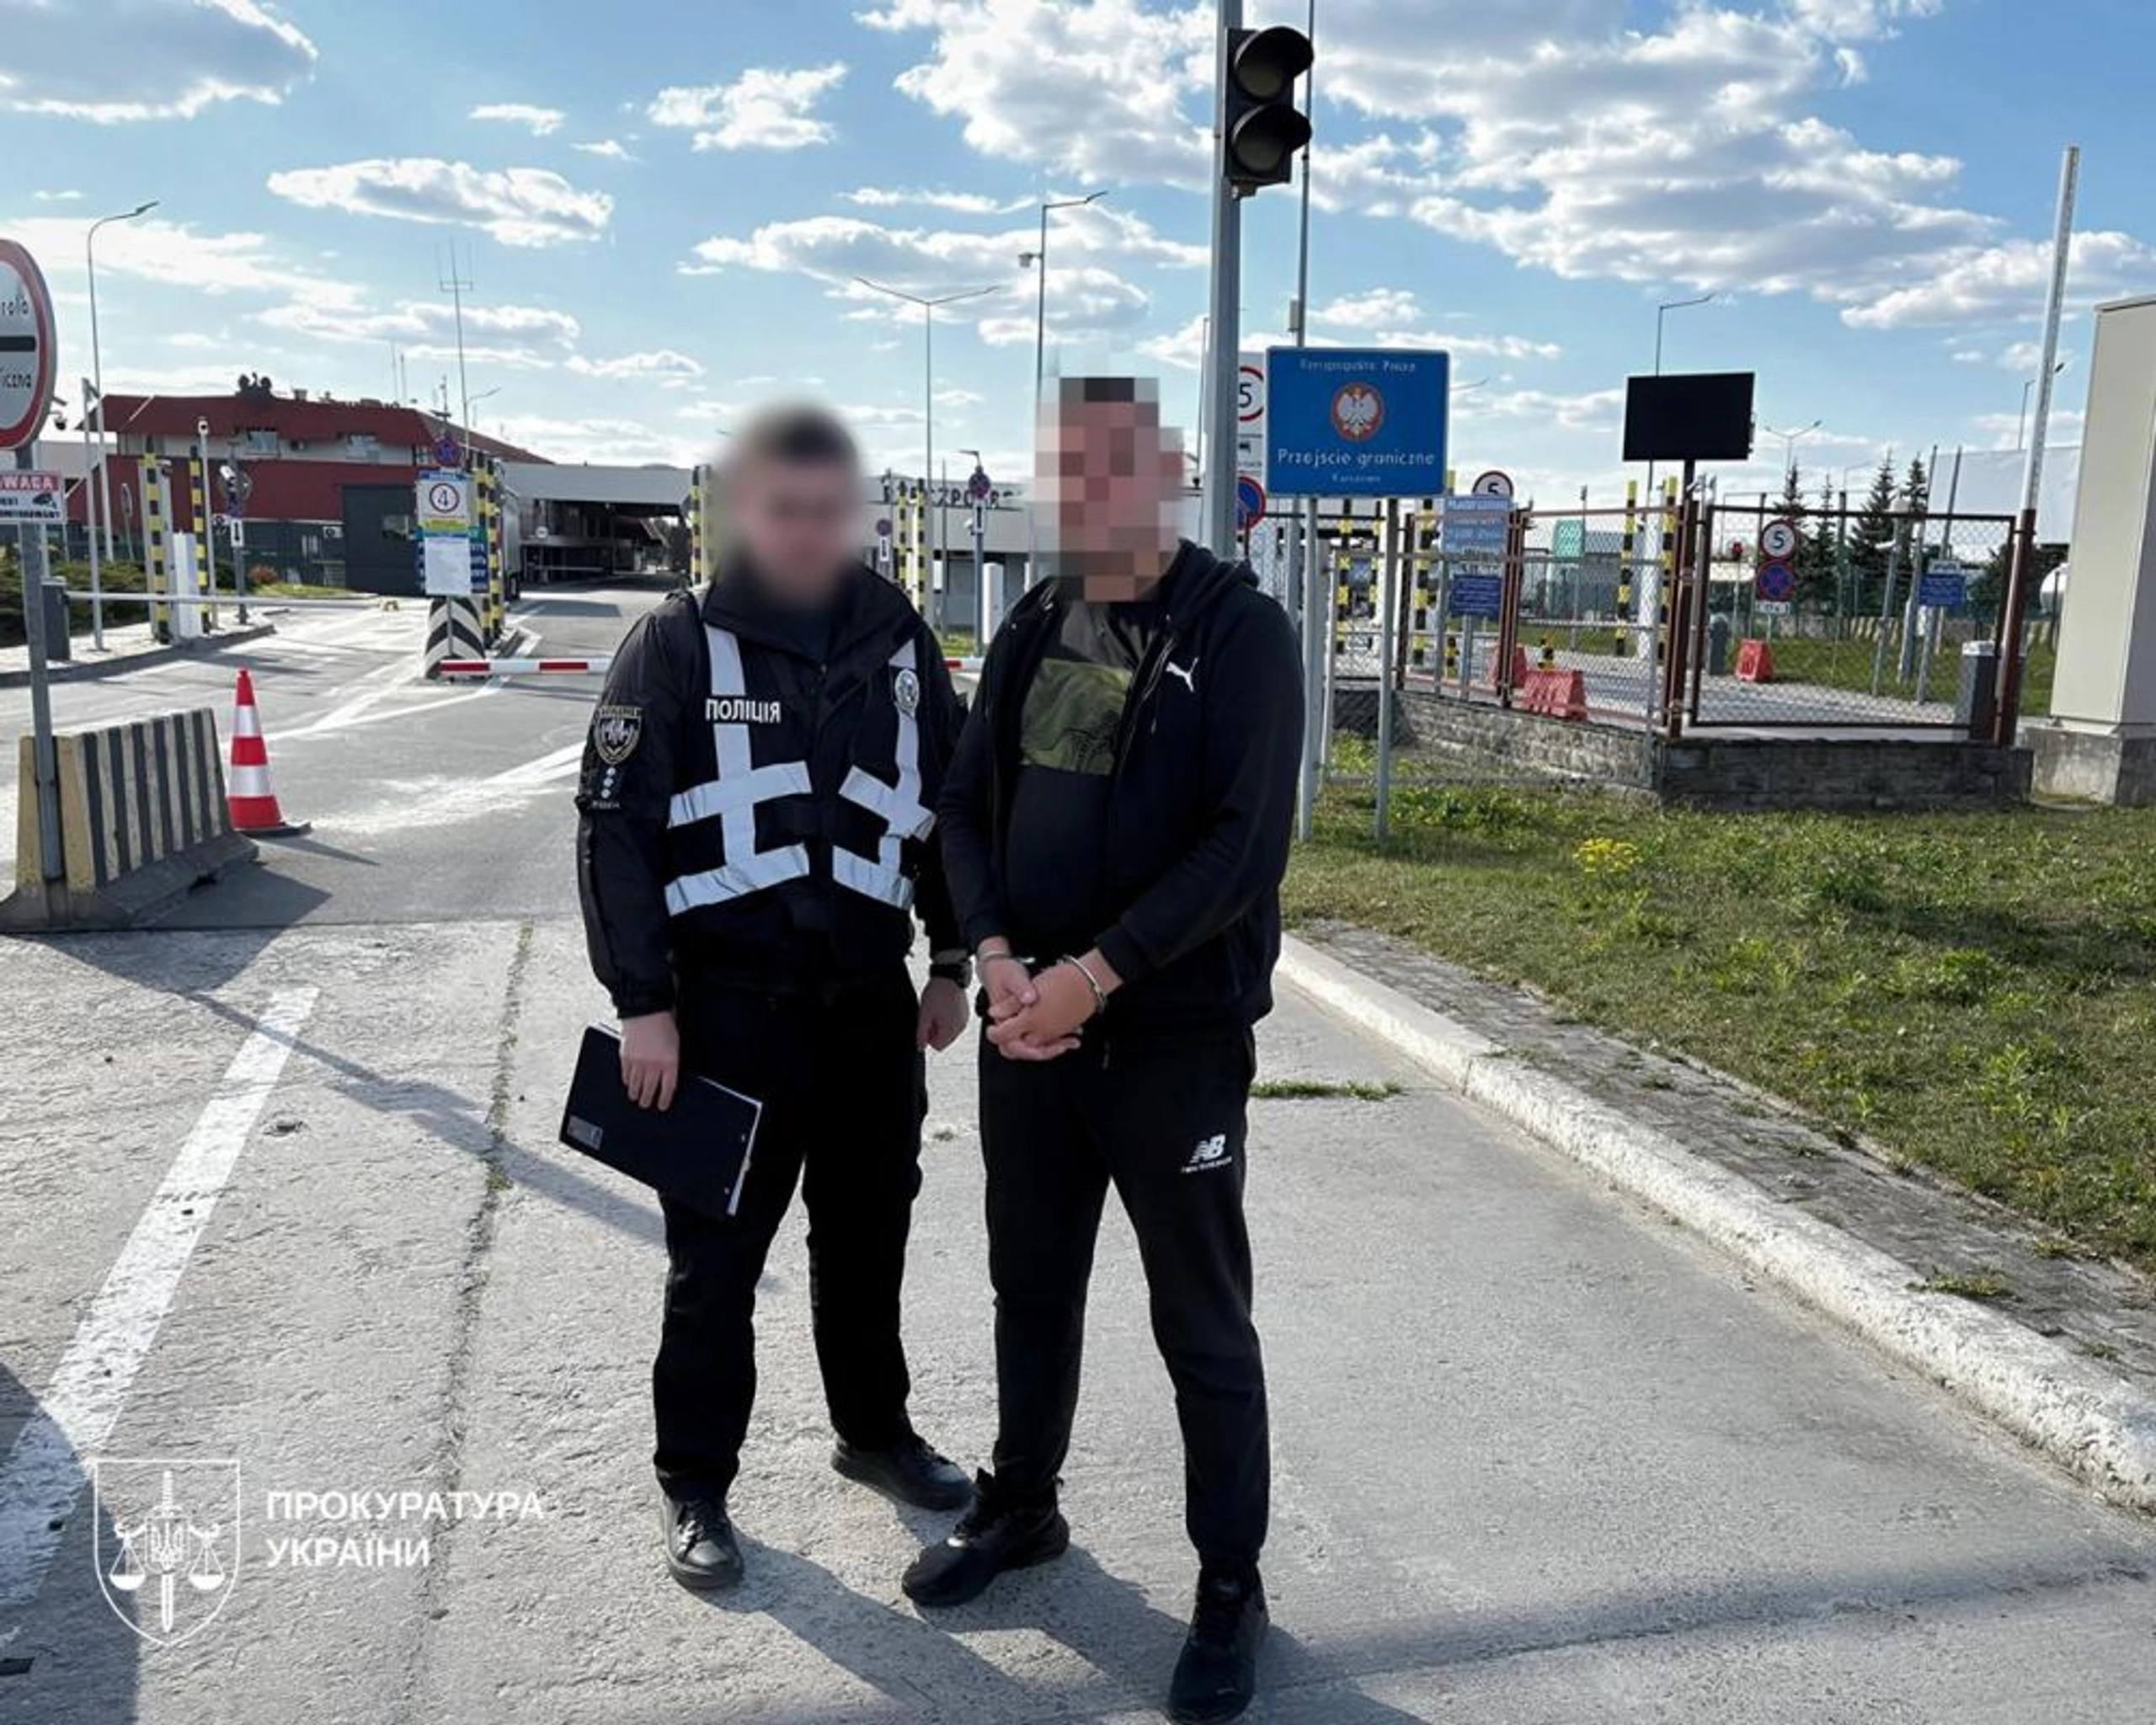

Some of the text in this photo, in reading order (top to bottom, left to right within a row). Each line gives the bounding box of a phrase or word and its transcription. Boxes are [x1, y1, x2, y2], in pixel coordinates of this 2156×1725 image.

[1239, 383, 1252, 409] 5
[1357, 447, 1435, 468] graniczne
[437, 489, 449, 506] 4
[1772, 530, 1785, 549] 5
[706, 698, 782, 724] ПОЛІЦІЯ
